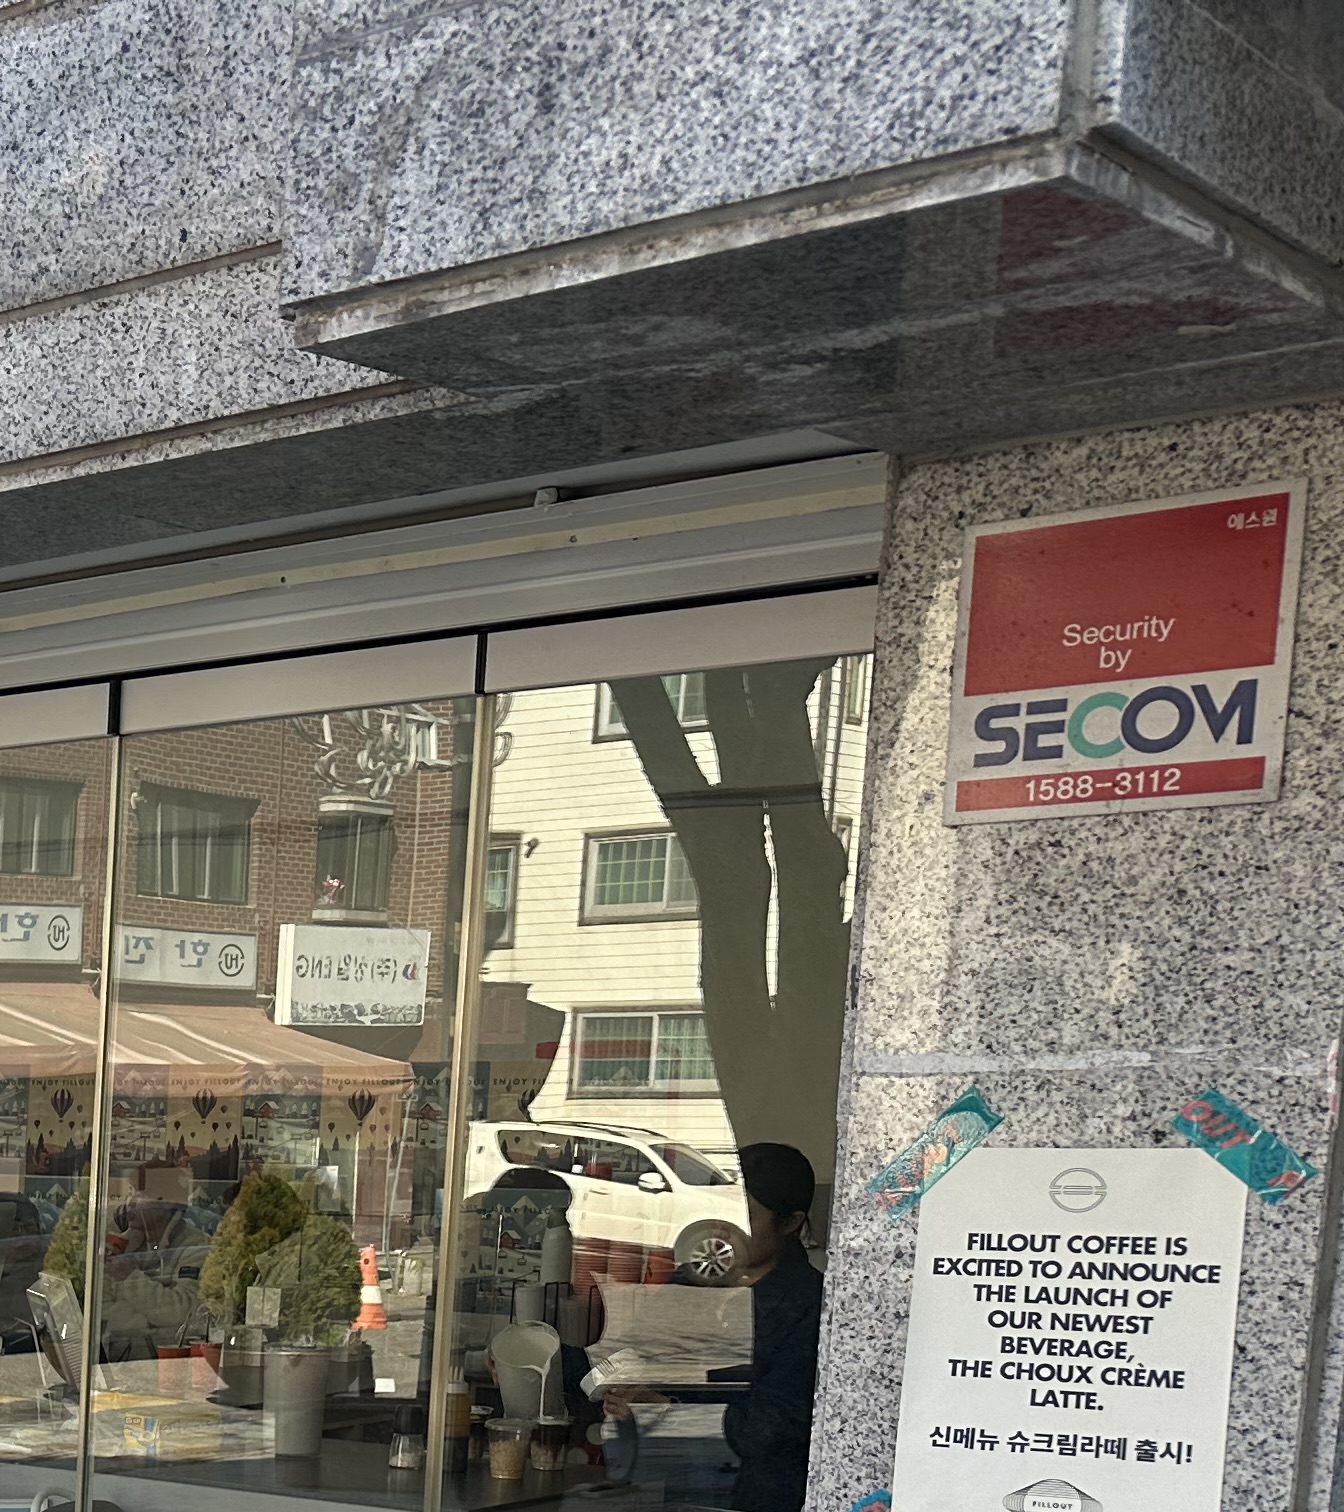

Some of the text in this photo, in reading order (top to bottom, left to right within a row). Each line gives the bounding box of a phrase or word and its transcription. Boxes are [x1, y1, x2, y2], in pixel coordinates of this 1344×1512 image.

[1227, 508, 1278, 531] 에스원
[1062, 616, 1175, 647] Security
[1099, 646, 1132, 672] by
[973, 678, 1259, 768] SECOM
[1025, 767, 1181, 802] 1588-3112
[967, 1232, 1188, 1256] FILLOUT COFFEE IS
[932, 1258, 1221, 1284] EXCITED TO ANNOUNCE
[973, 1284, 1172, 1309] THE LAUNCH OF
[987, 1310, 1153, 1334] OUR NEWEST
[1000, 1336, 1135, 1364] BEVERAGE,
[948, 1359, 1185, 1389] THE CHOUX CRÈME
[1029, 1389, 1104, 1411] LATTE.
[929, 1426, 1193, 1465] 신메뉴 슈크림라떼 출시!
[1032, 1500, 1073, 1510] FILLOUT
